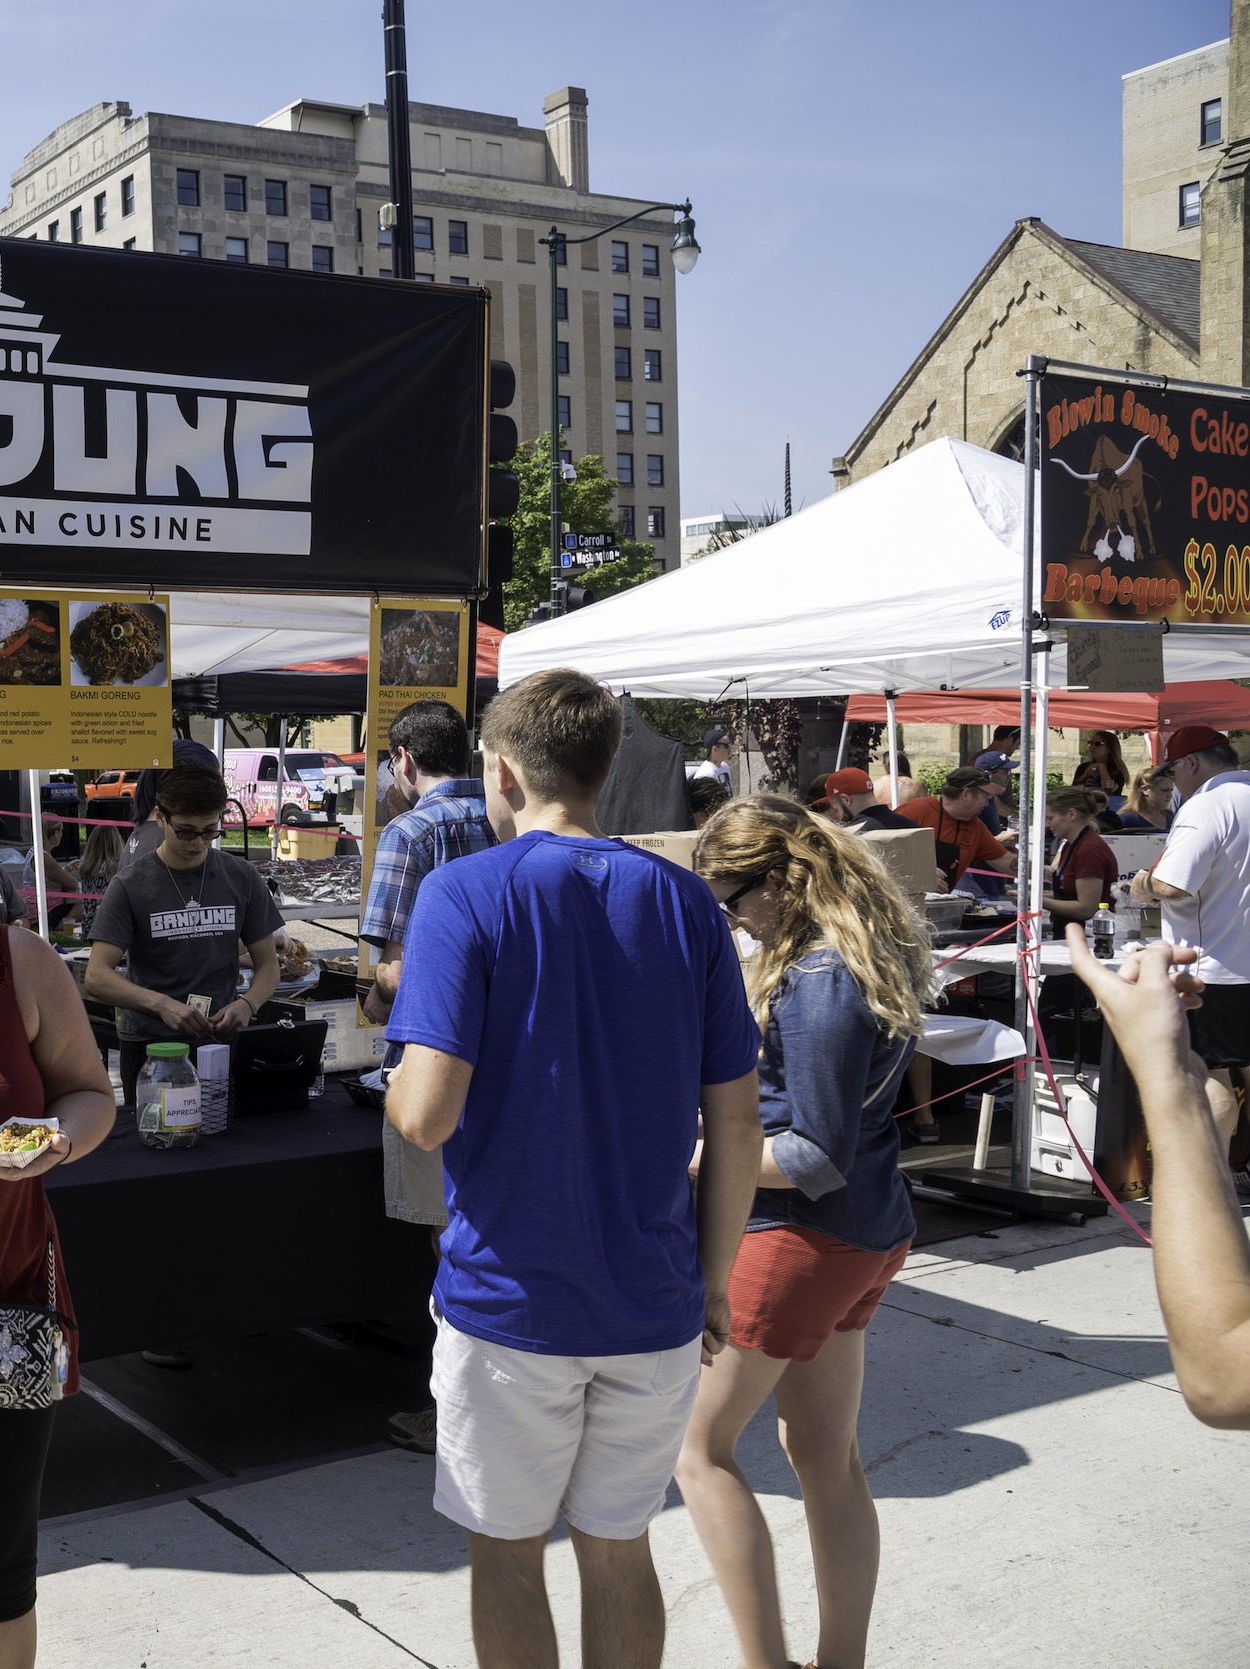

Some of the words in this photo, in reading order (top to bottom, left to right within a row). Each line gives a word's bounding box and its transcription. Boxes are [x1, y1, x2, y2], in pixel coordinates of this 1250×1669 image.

[1047, 386, 1115, 449] Blowin
[1121, 390, 1179, 459] Smoke
[1190, 408, 1249, 457] Cake
[1191, 475, 1249, 523] Pops
[57, 511, 213, 543] CUISINE
[579, 535, 604, 546] Carroll
[576, 550, 614, 564] Washington
[1044, 562, 1180, 614] Barbeque
[70, 691, 99, 700] BAKMI
[101, 692, 140, 700] GORENG
[396, 691, 412, 699] THAI
[104, 711, 117, 719] style
[642, 839, 665, 847] FROZEN
[150, 908, 235, 931] BANDUNG
